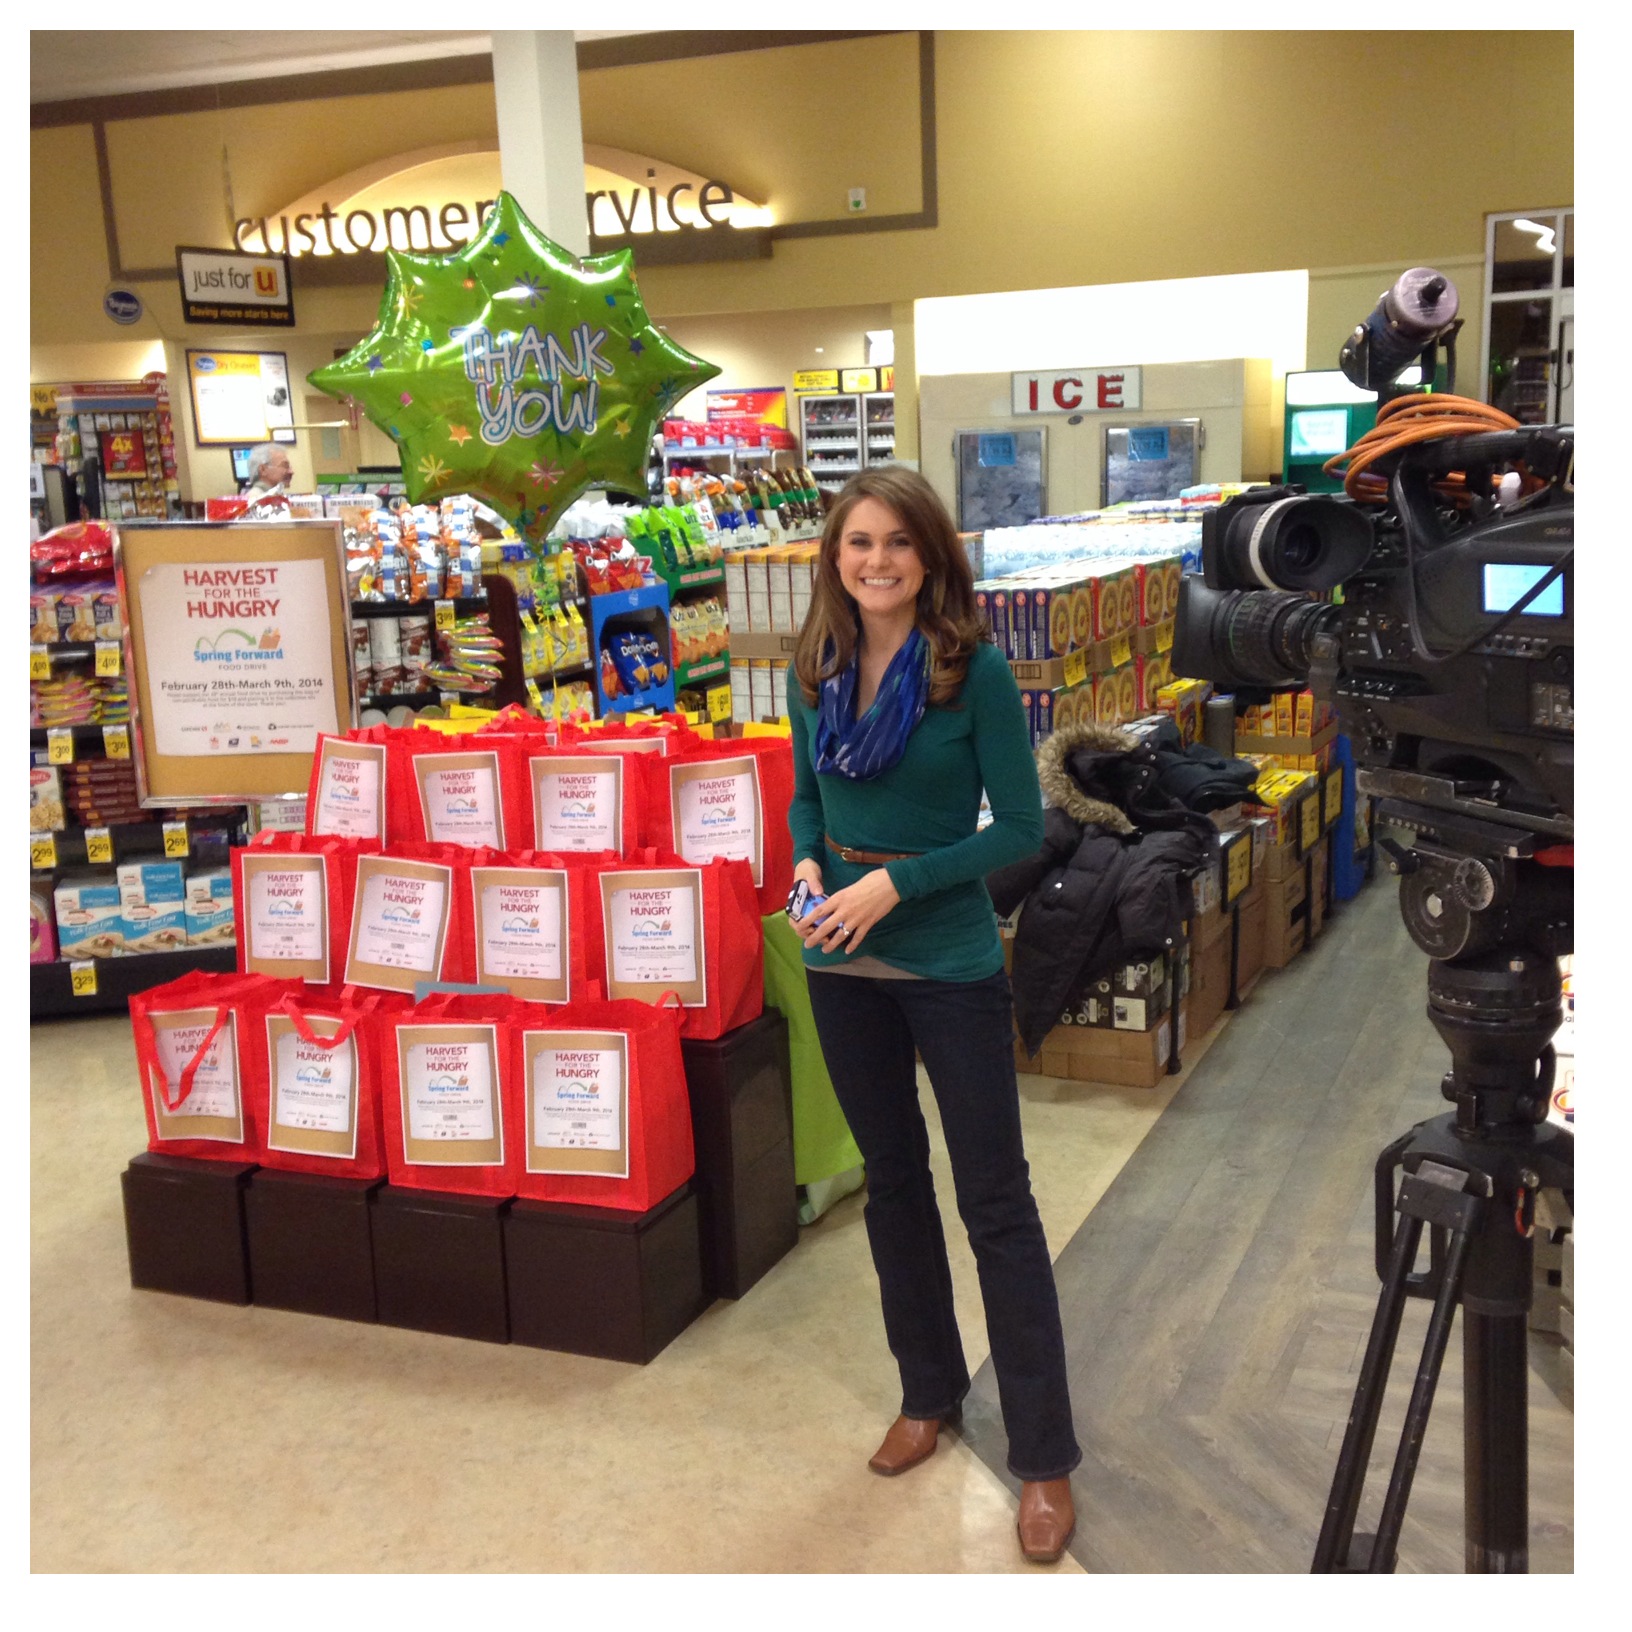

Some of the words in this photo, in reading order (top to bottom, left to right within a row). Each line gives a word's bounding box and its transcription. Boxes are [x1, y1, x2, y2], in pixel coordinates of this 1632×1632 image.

[232, 200, 496, 257] customer
[587, 169, 735, 237] rvice
[193, 267, 225, 293] just
[228, 266, 251, 289] for
[190, 306, 218, 319] Saving
[220, 309, 243, 318] more
[244, 309, 269, 319] starts
[271, 310, 289, 319] here
[450, 323, 615, 383] THANK
[1028, 373, 1125, 411] ICE
[475, 380, 599, 446] YOU!
[183, 568, 279, 586] HARVEST
[204, 588, 231, 599] FOR
[234, 587, 261, 598] THE
[187, 599, 281, 618] HUNGRY
[193, 649, 232, 663] Spring
[235, 648, 284, 661] Forward
[161, 682, 208, 692] February
[211, 679, 271, 689] 28th-March
[274, 679, 295, 689] 9th,
[298, 677, 324, 688] 2014
